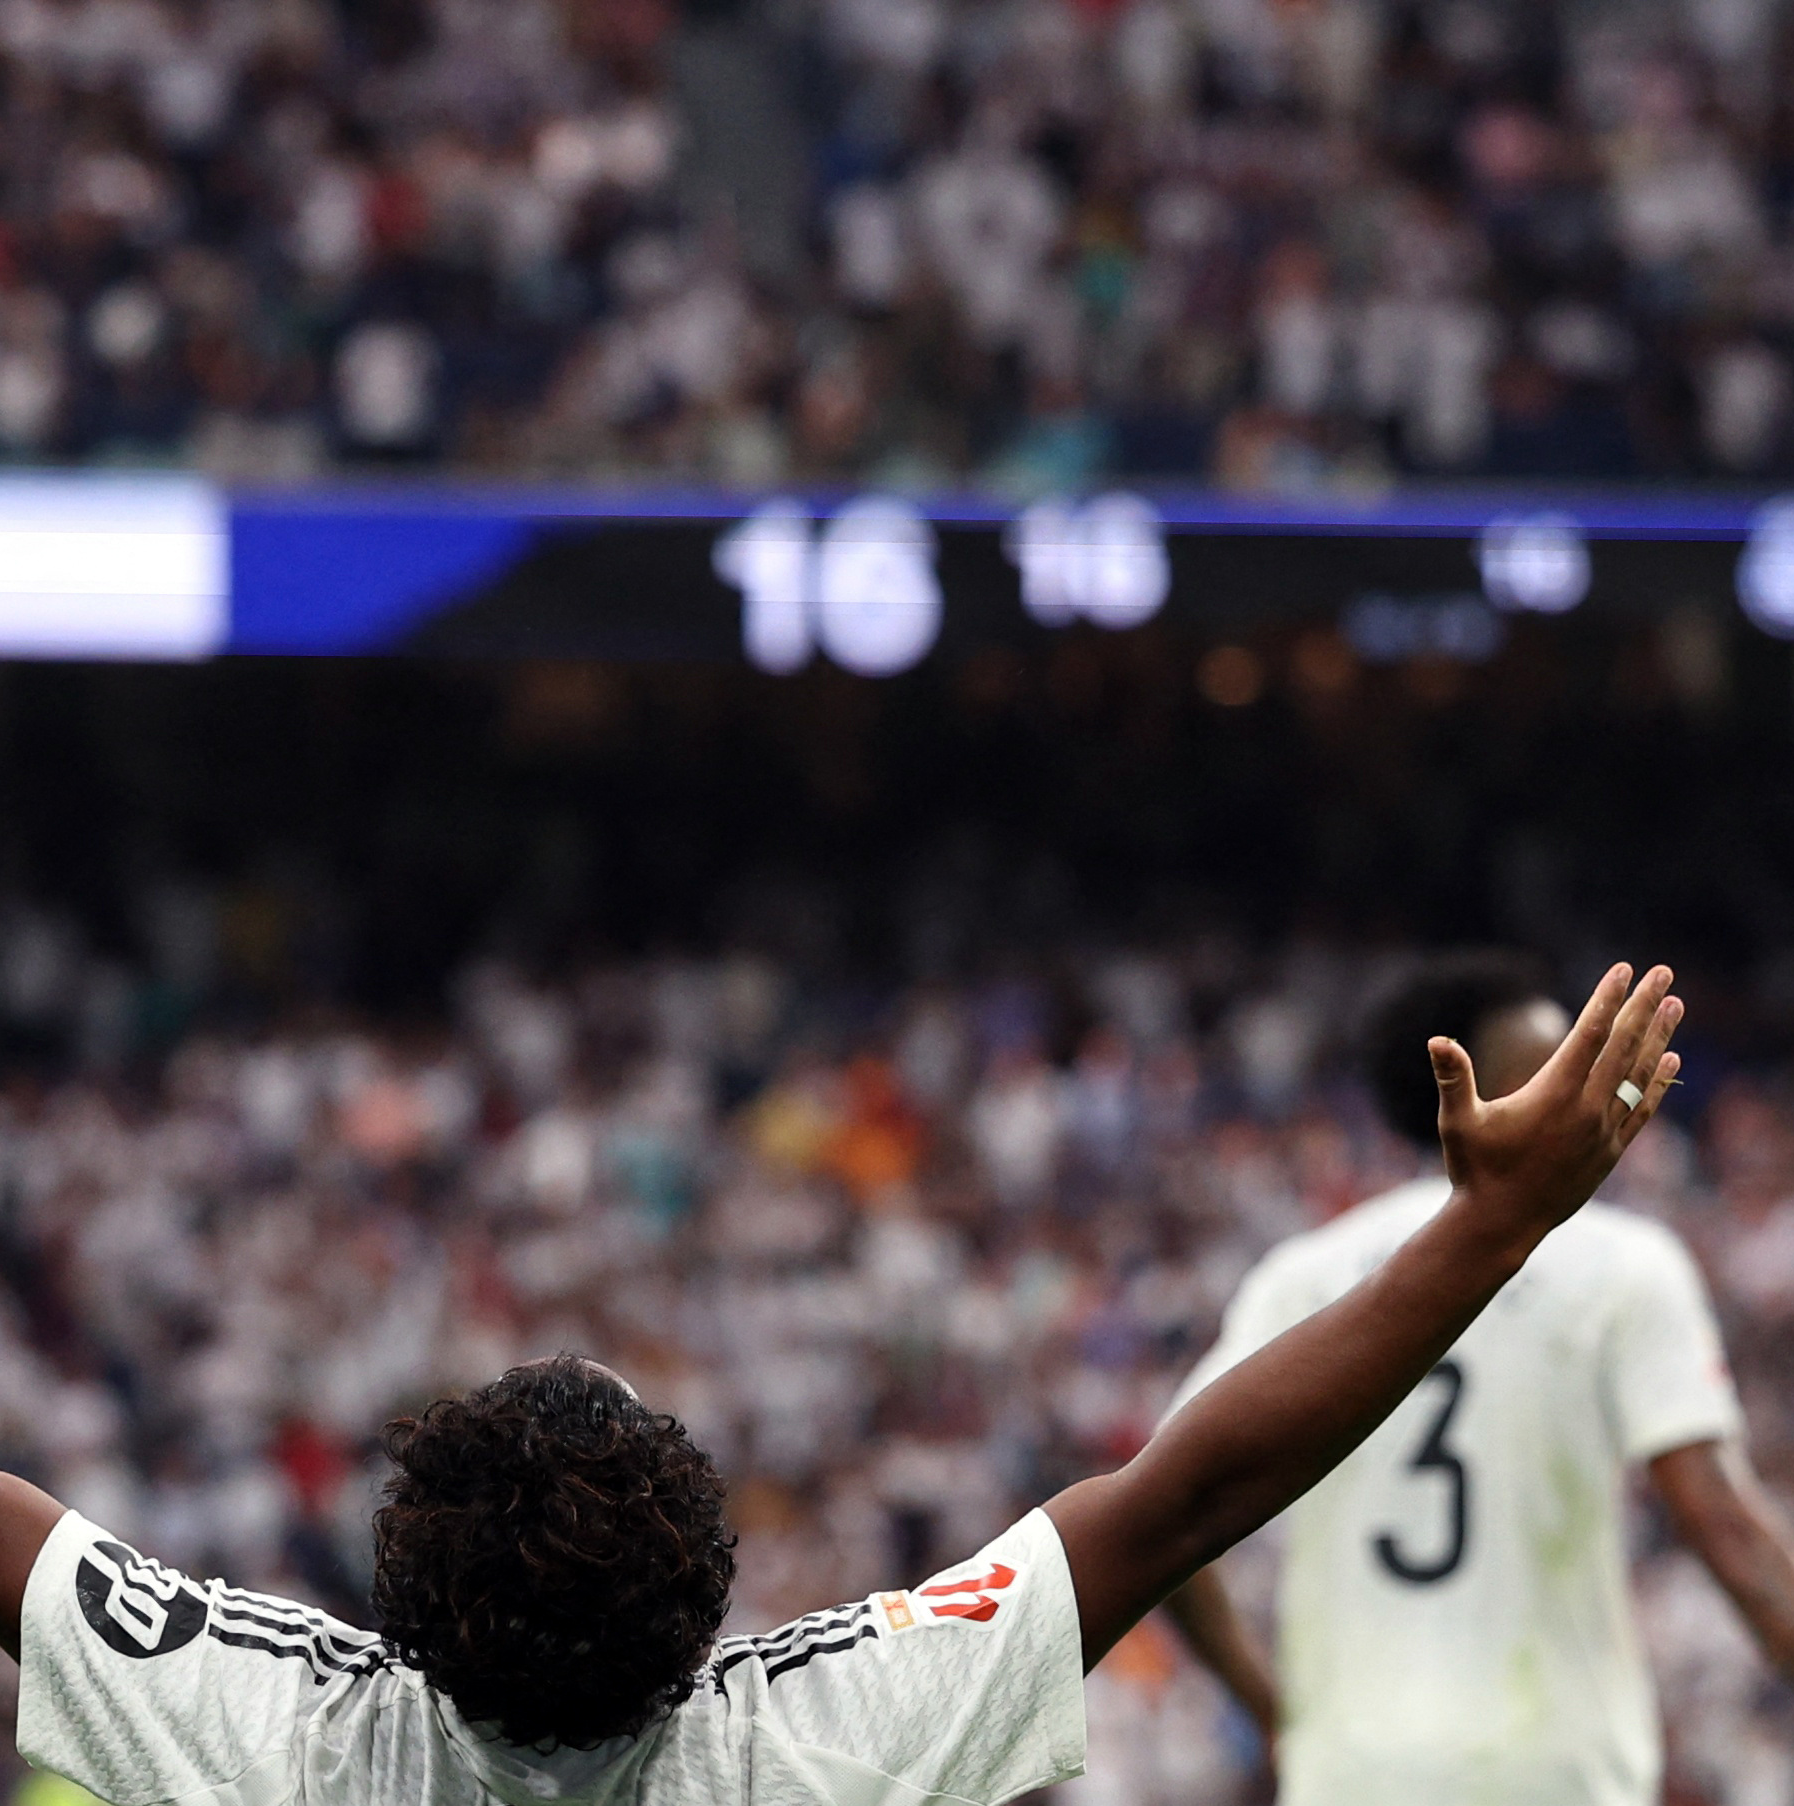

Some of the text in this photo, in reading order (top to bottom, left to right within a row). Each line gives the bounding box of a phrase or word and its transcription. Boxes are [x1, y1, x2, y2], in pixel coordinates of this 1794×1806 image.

[712, 498, 943, 678] 16
[1004, 495, 1171, 630] 16
[1373, 1352, 1472, 1587] 3
